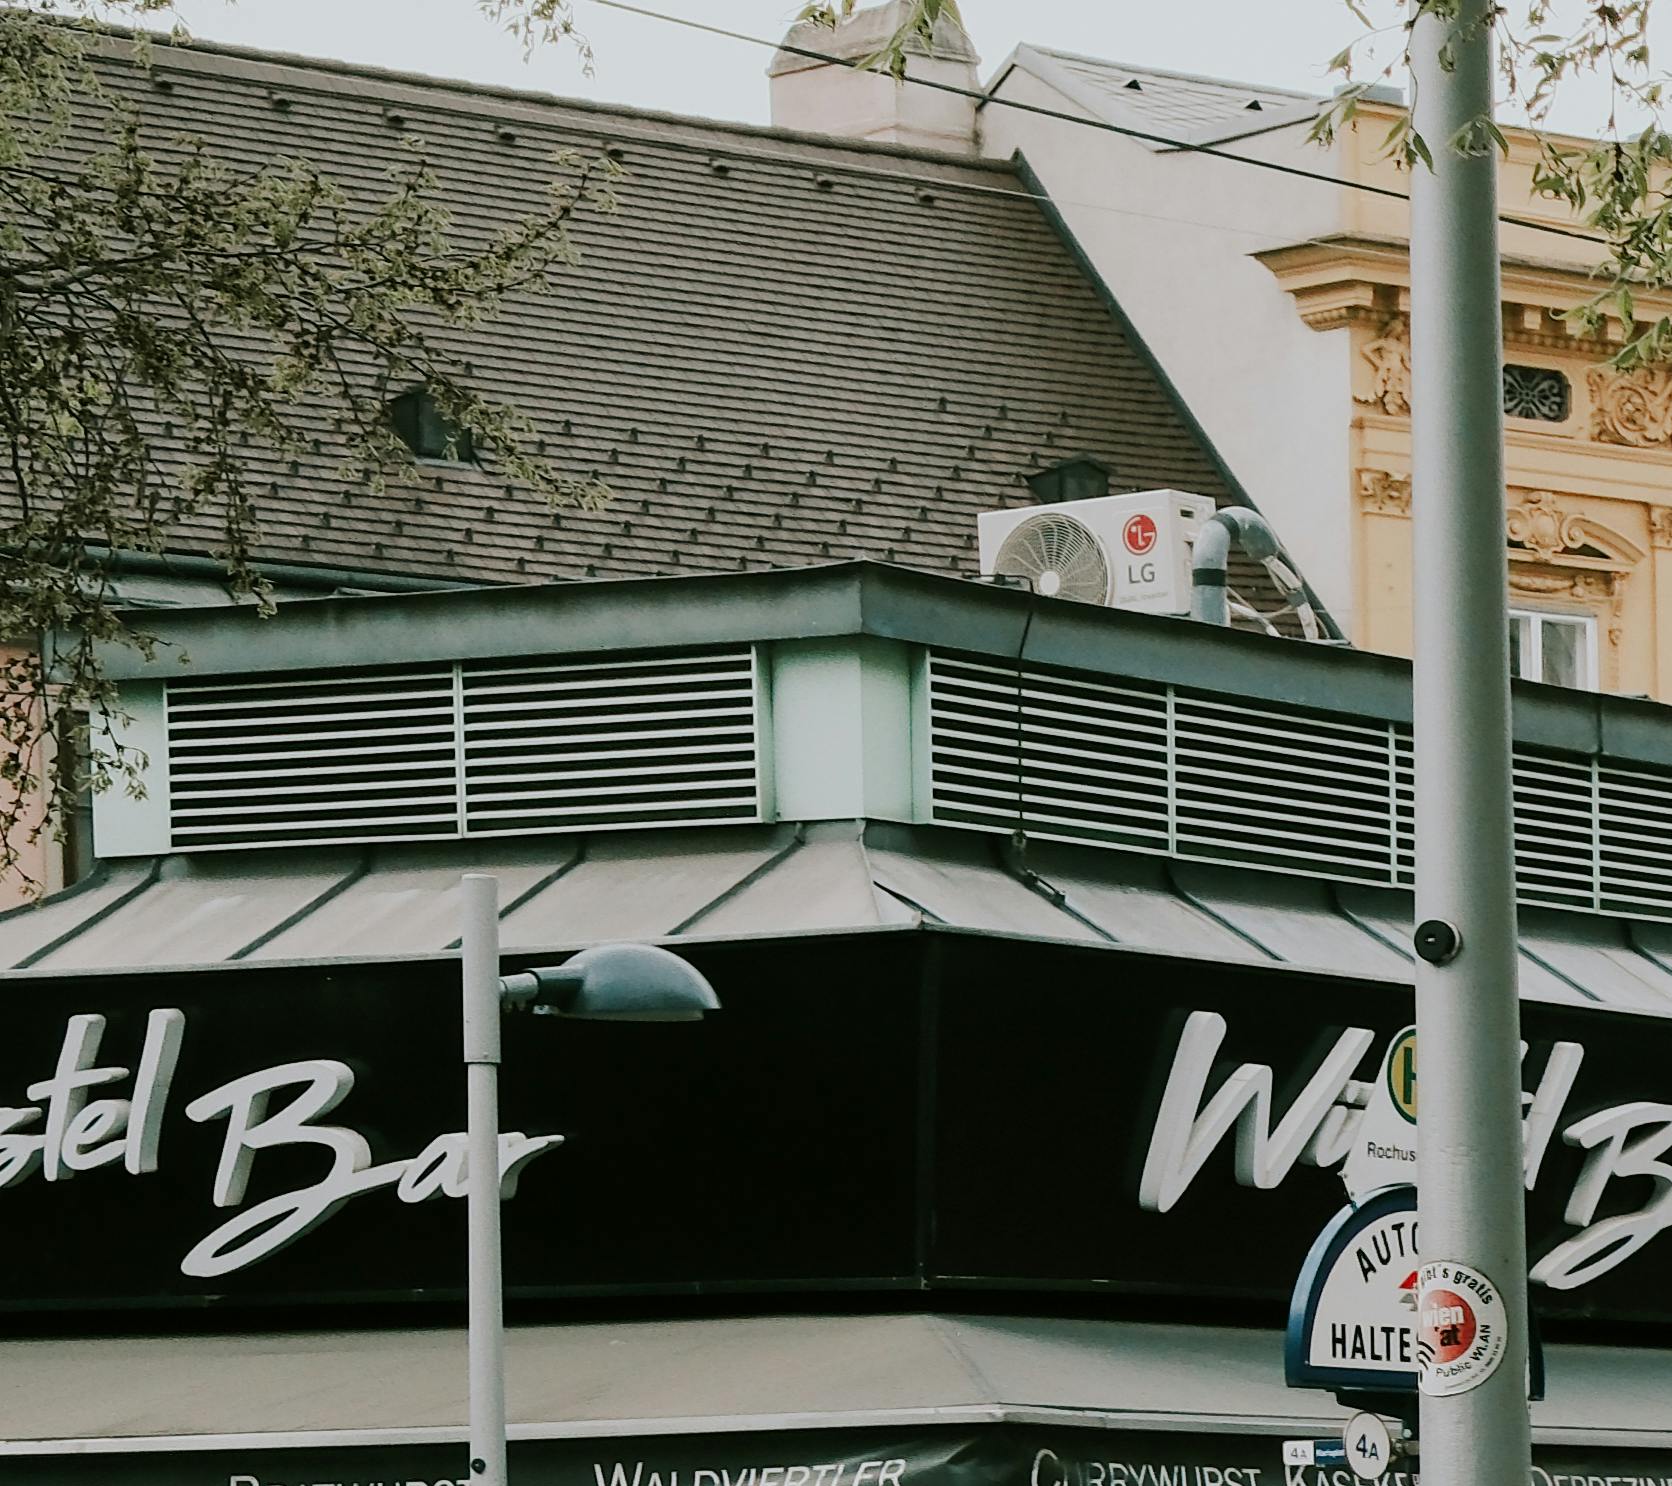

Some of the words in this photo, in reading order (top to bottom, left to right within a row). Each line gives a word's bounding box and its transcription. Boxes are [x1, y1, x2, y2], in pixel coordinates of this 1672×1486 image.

[1128, 562, 1156, 584] LG
[1331, 1322, 1412, 1363] HALTE
[1356, 1434, 1380, 1460] 4A
